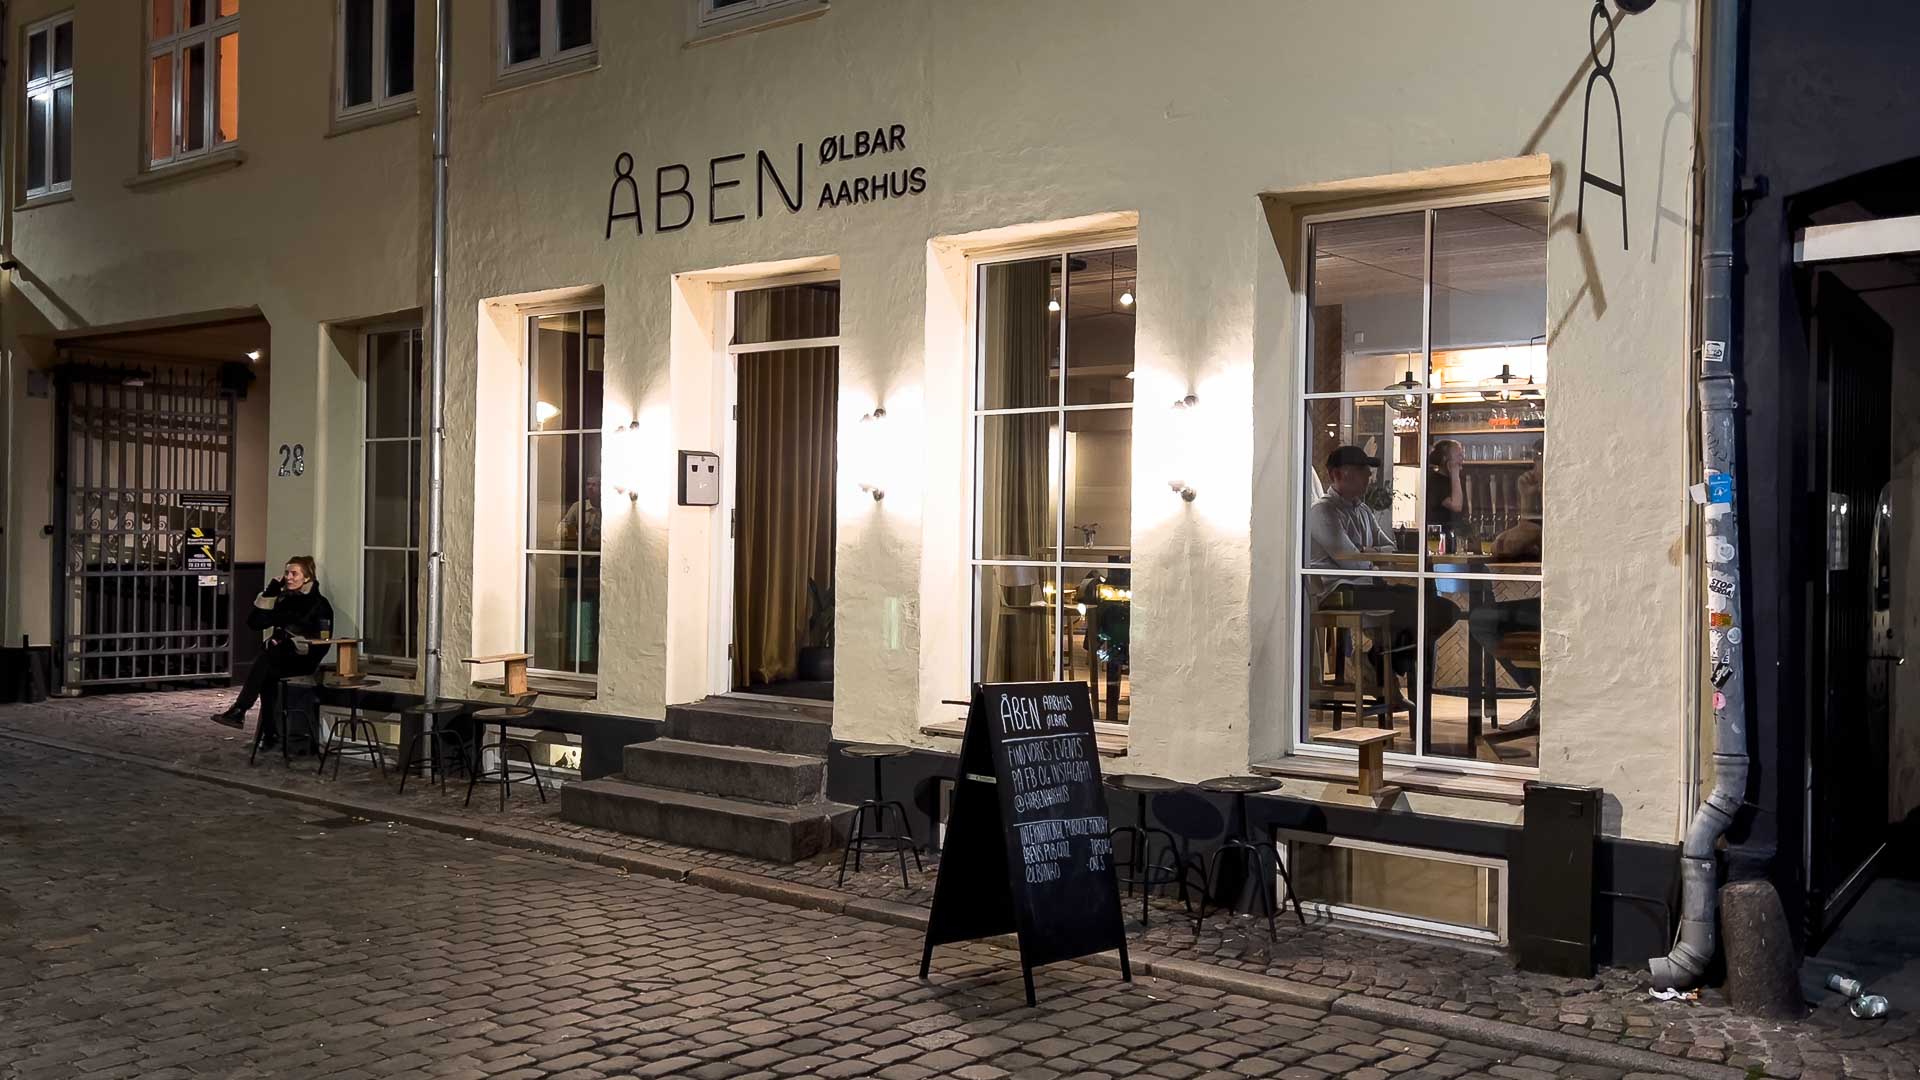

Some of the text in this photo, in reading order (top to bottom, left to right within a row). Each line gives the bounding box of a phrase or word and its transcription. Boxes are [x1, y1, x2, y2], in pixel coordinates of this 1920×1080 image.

[819, 124, 906, 165] ØLBAR
[605, 143, 804, 240] ÅBEN
[817, 167, 927, 210] AARHUS
[278, 444, 304, 476] 28
[1711, 578, 1733, 589] STOP
[1000, 693, 1042, 734] ÅBEN
[1046, 713, 1069, 729] ØLBAR
[1023, 740, 1052, 764] VORES
[1053, 737, 1084, 760] EVENTS
[1024, 766, 1038, 790] FB
